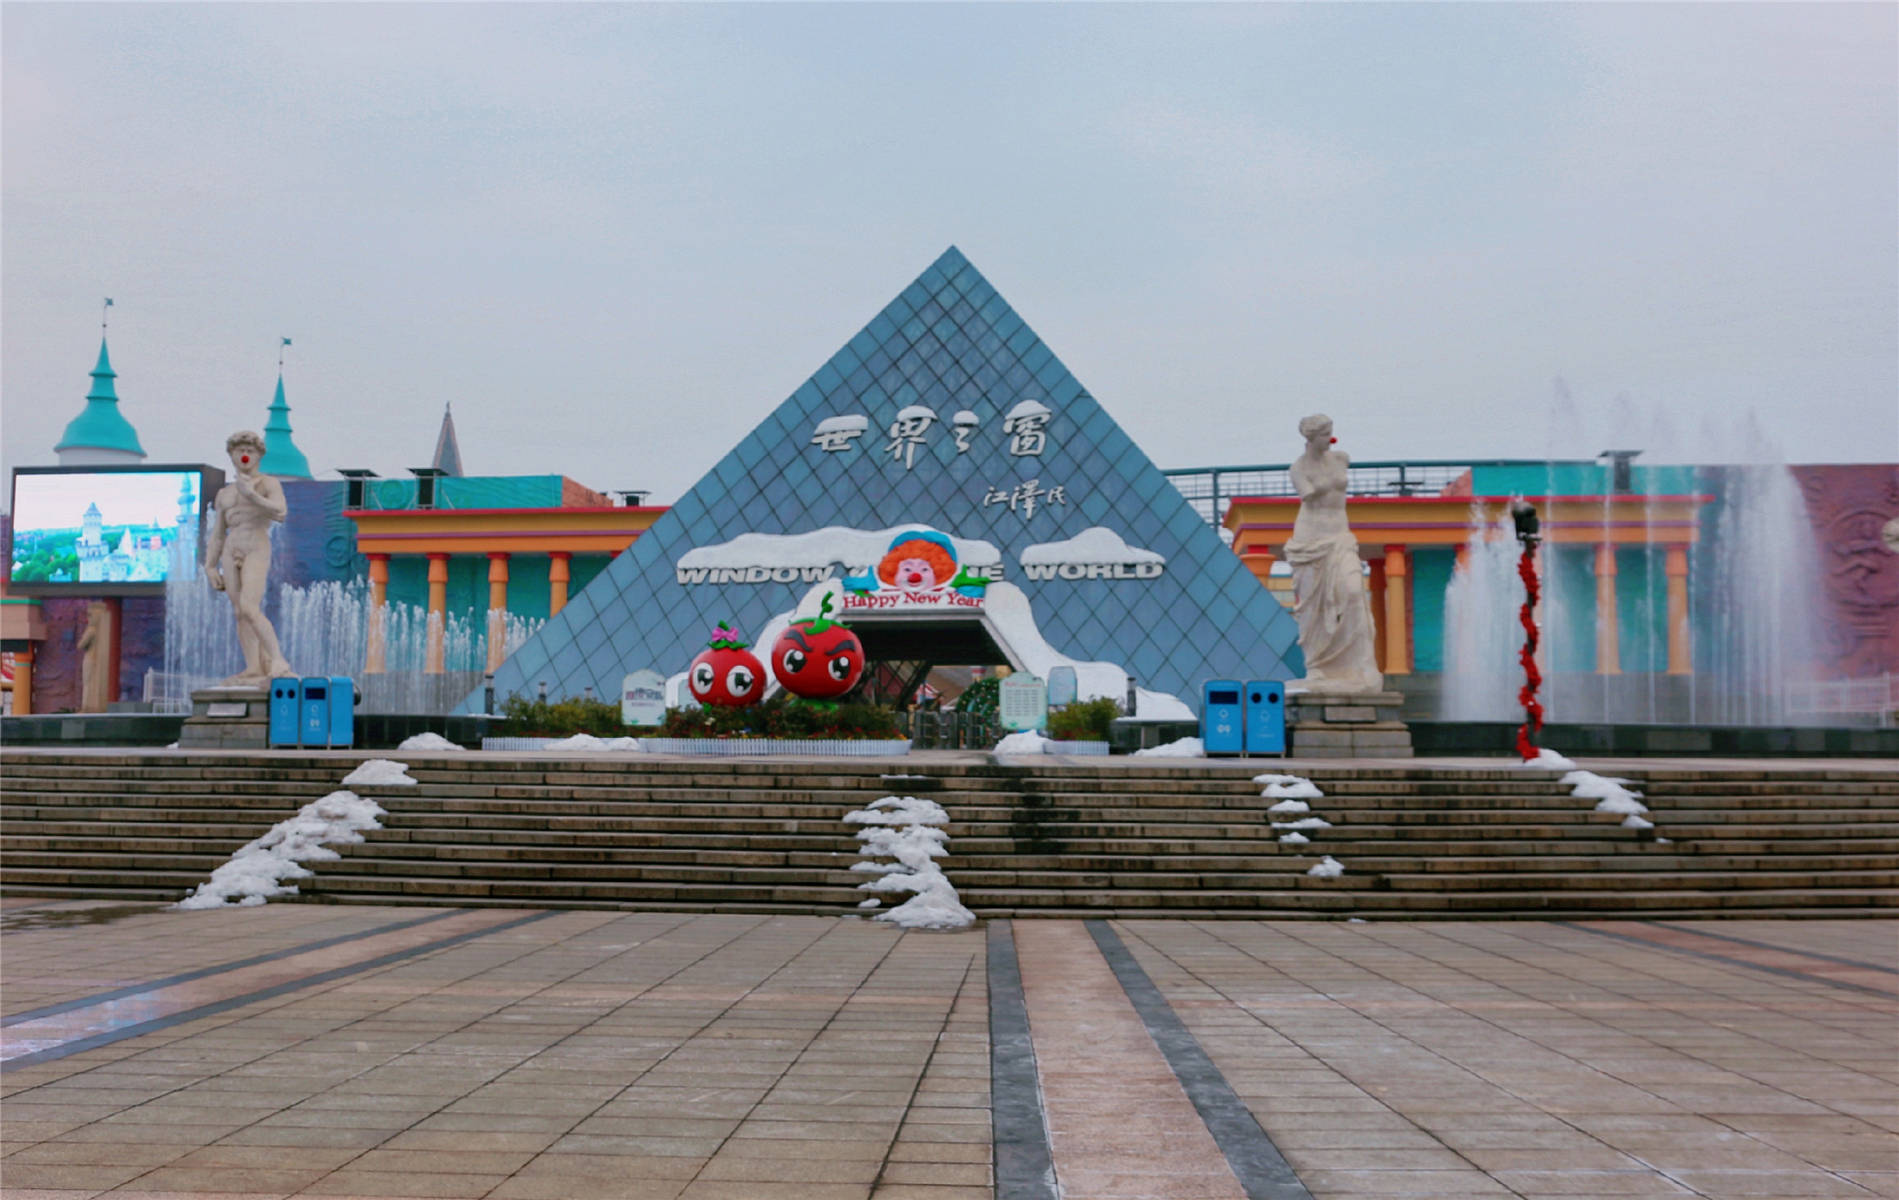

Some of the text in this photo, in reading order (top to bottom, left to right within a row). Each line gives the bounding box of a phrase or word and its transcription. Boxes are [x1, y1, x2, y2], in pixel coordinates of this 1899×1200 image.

[677, 566, 835, 585] WINDOW
[1023, 564, 1164, 581] WORLD
[843, 592, 984, 609] Happy New Year
